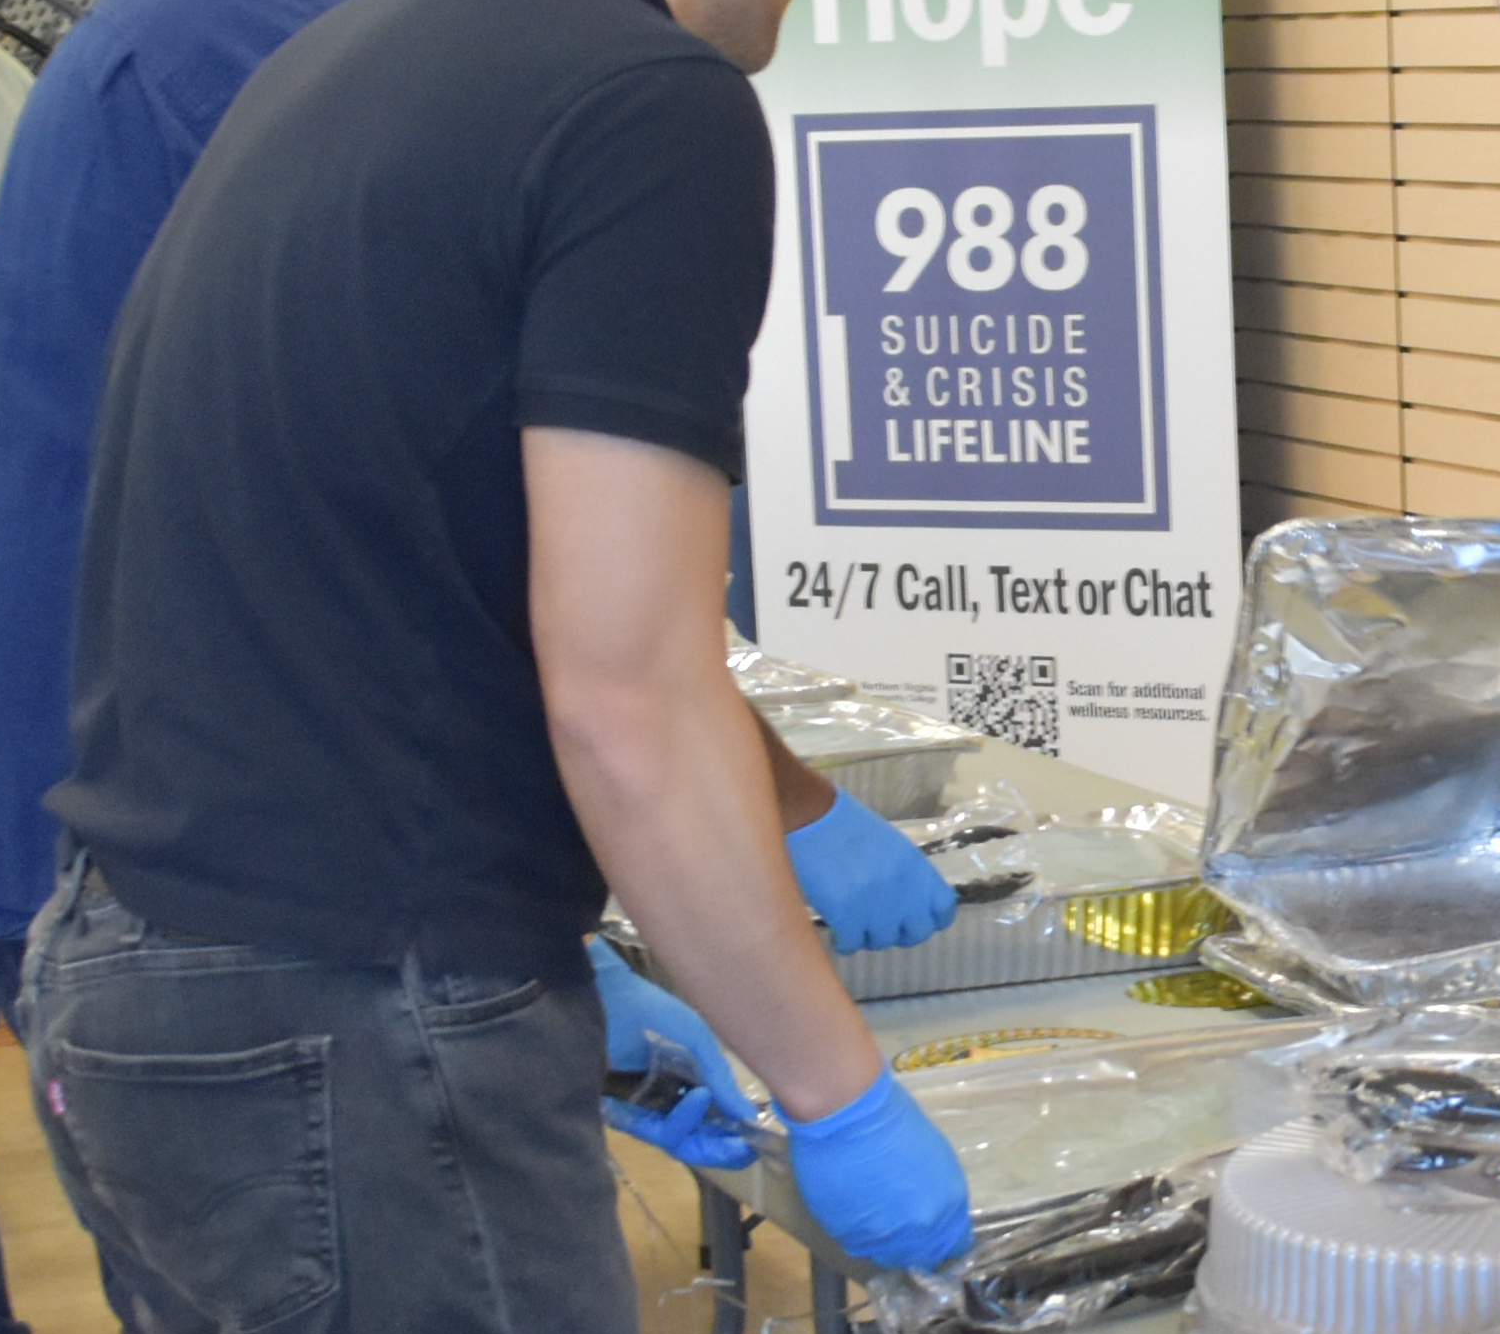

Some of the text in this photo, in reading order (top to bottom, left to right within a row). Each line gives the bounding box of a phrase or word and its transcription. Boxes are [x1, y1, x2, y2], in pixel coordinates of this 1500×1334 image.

[874, 184, 1089, 292] 988
[880, 313, 1087, 356] SUICIDE
[883, 366, 1089, 407] & CRISIS
[885, 418, 1091, 464] LIFELINE
[787, 561, 1213, 623] 24/7 Call, Text or Chat
[1066, 680, 1206, 700] Scan for additional
[1067, 702, 1210, 721] wellness resources.
